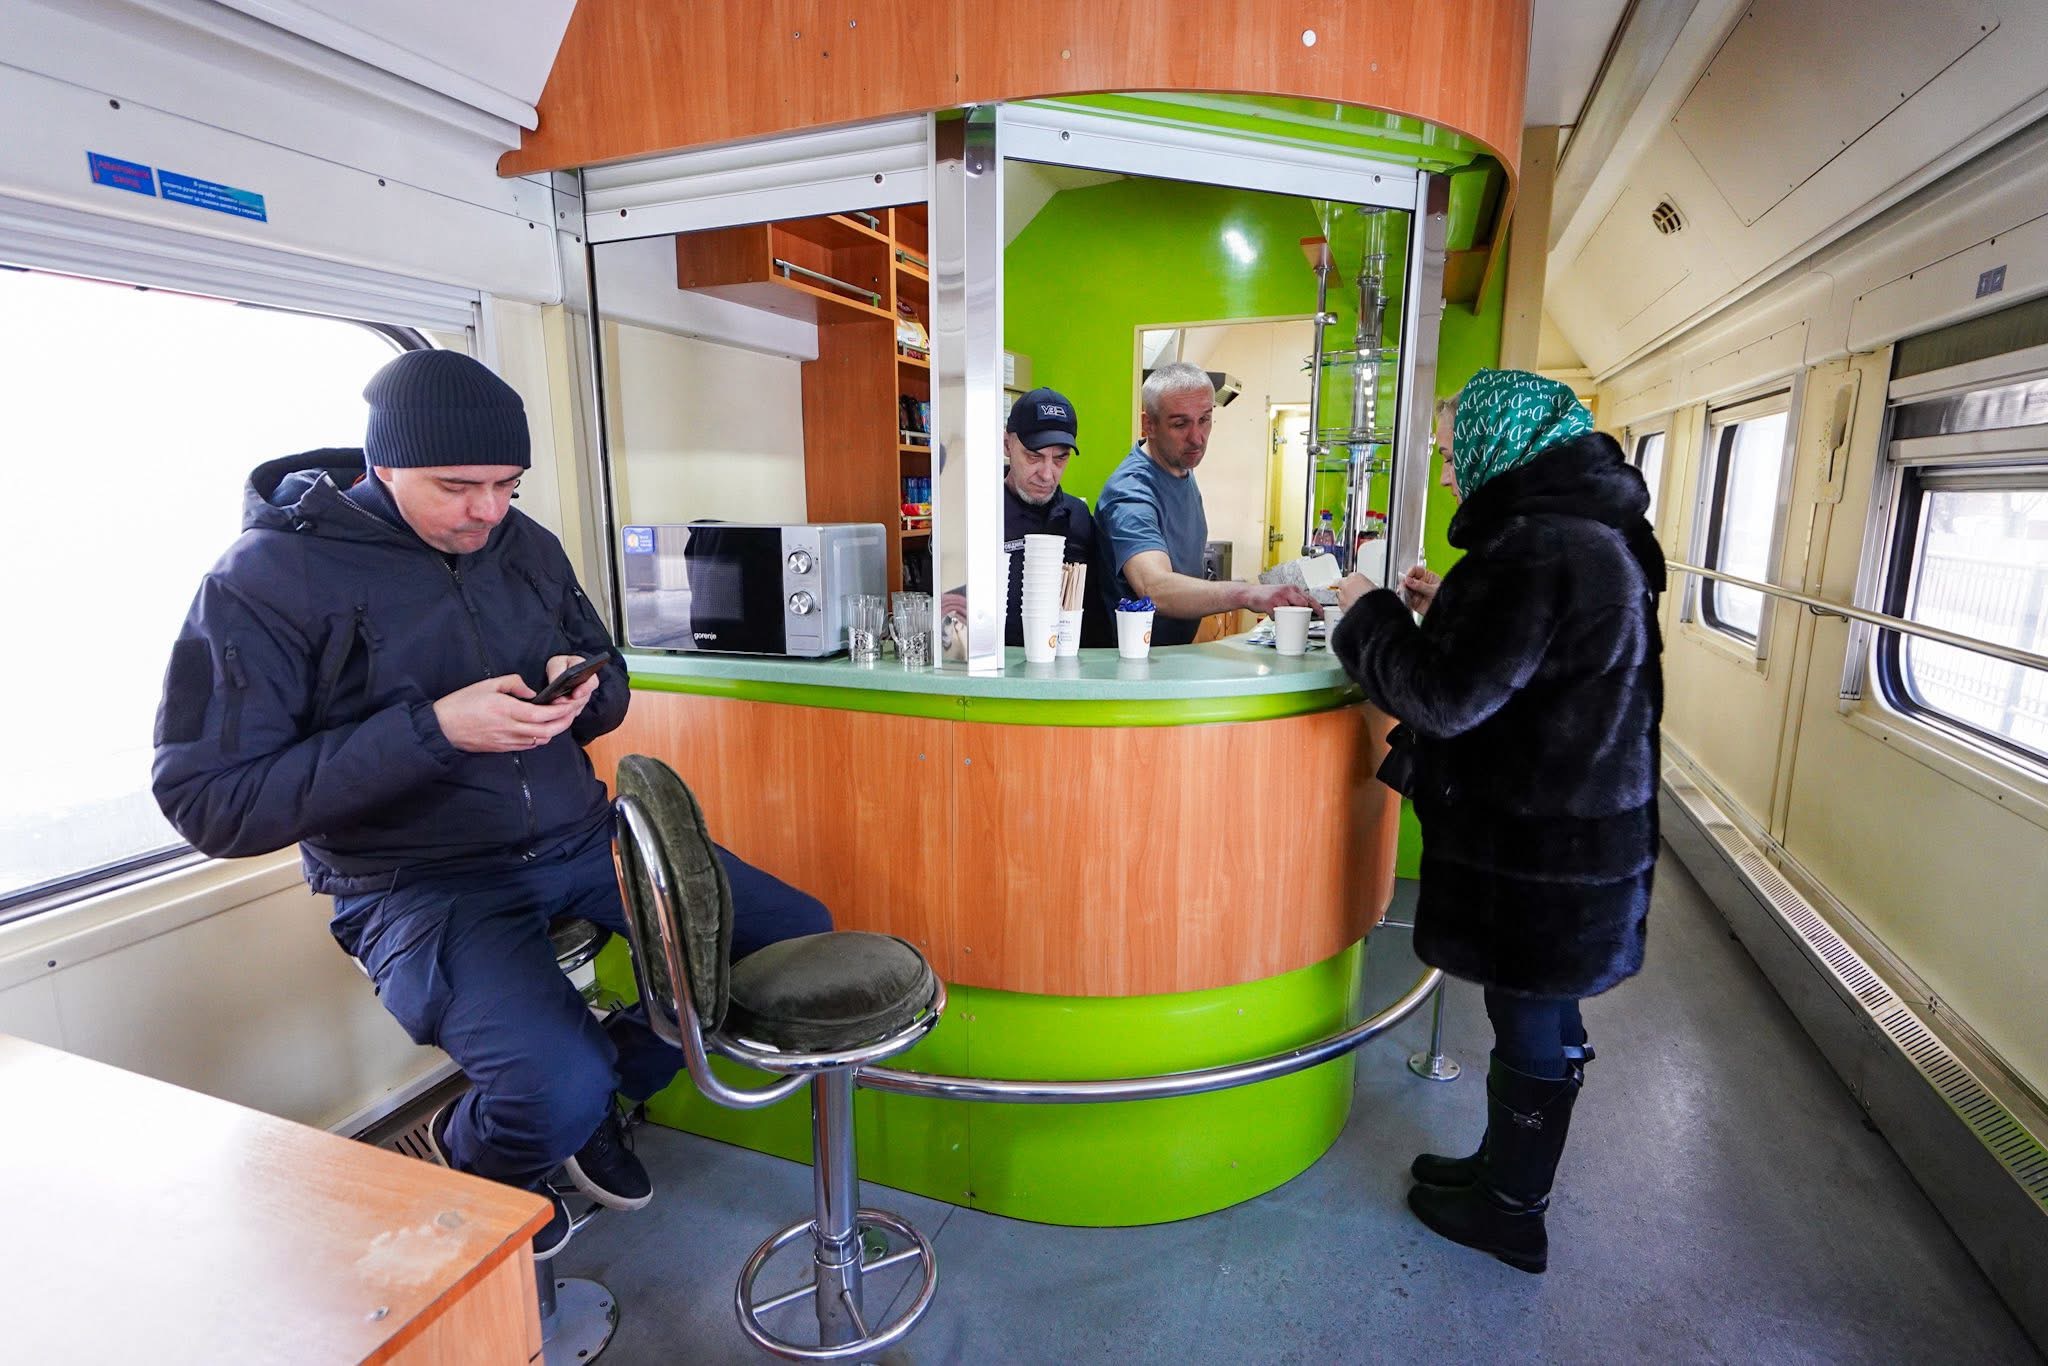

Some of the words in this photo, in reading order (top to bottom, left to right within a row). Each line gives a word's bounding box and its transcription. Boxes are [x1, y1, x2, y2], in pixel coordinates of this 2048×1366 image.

[1513, 380, 1548, 391] Dior
[1496, 392, 1532, 412] Dior
[1516, 405, 1551, 421] Dior
[694, 632, 717, 640] gorenje
